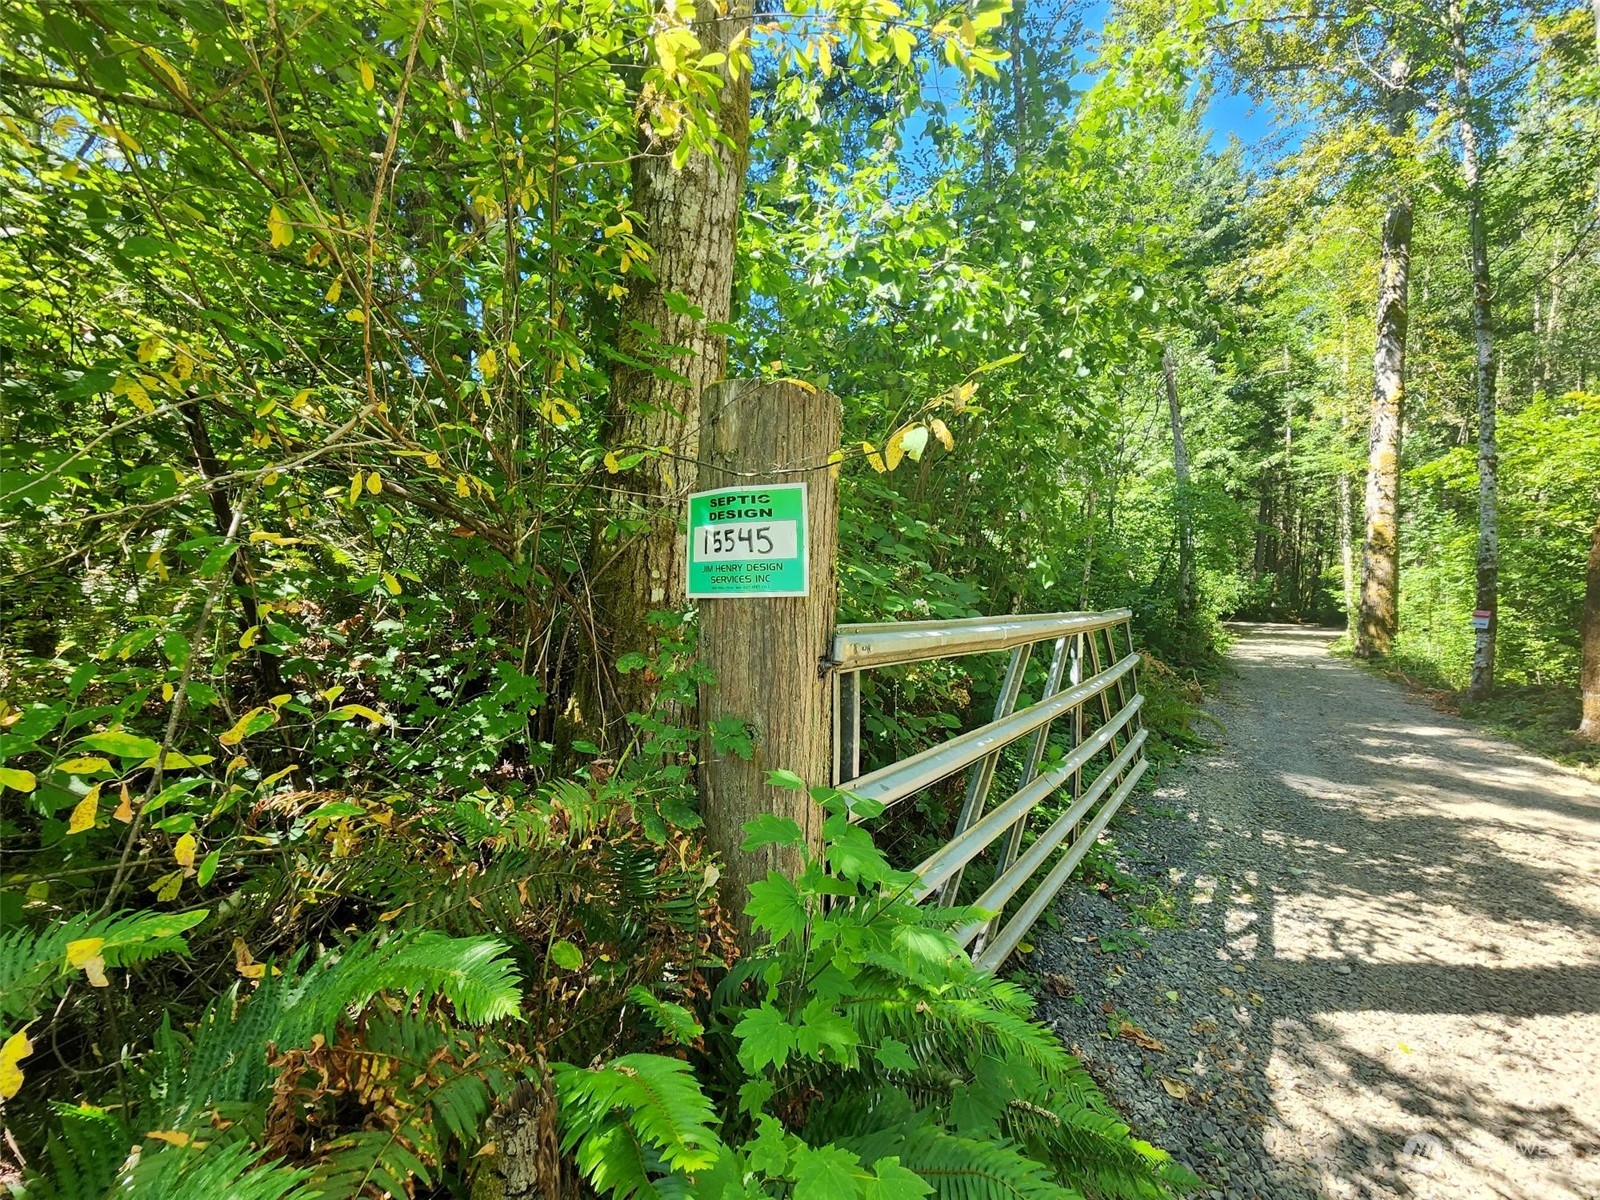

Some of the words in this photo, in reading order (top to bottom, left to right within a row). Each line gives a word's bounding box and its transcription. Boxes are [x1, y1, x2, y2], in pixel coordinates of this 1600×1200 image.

[710, 494, 771, 508] SEPTIC
[709, 508, 773, 521] DESIGN
[704, 526, 774, 555] 15545
[702, 566, 713, 574] JIM
[715, 564, 743, 573] HENRY
[746, 562, 783, 571] DESIGN
[710, 575, 752, 584] SERVICES
[755, 574, 771, 583] INC
